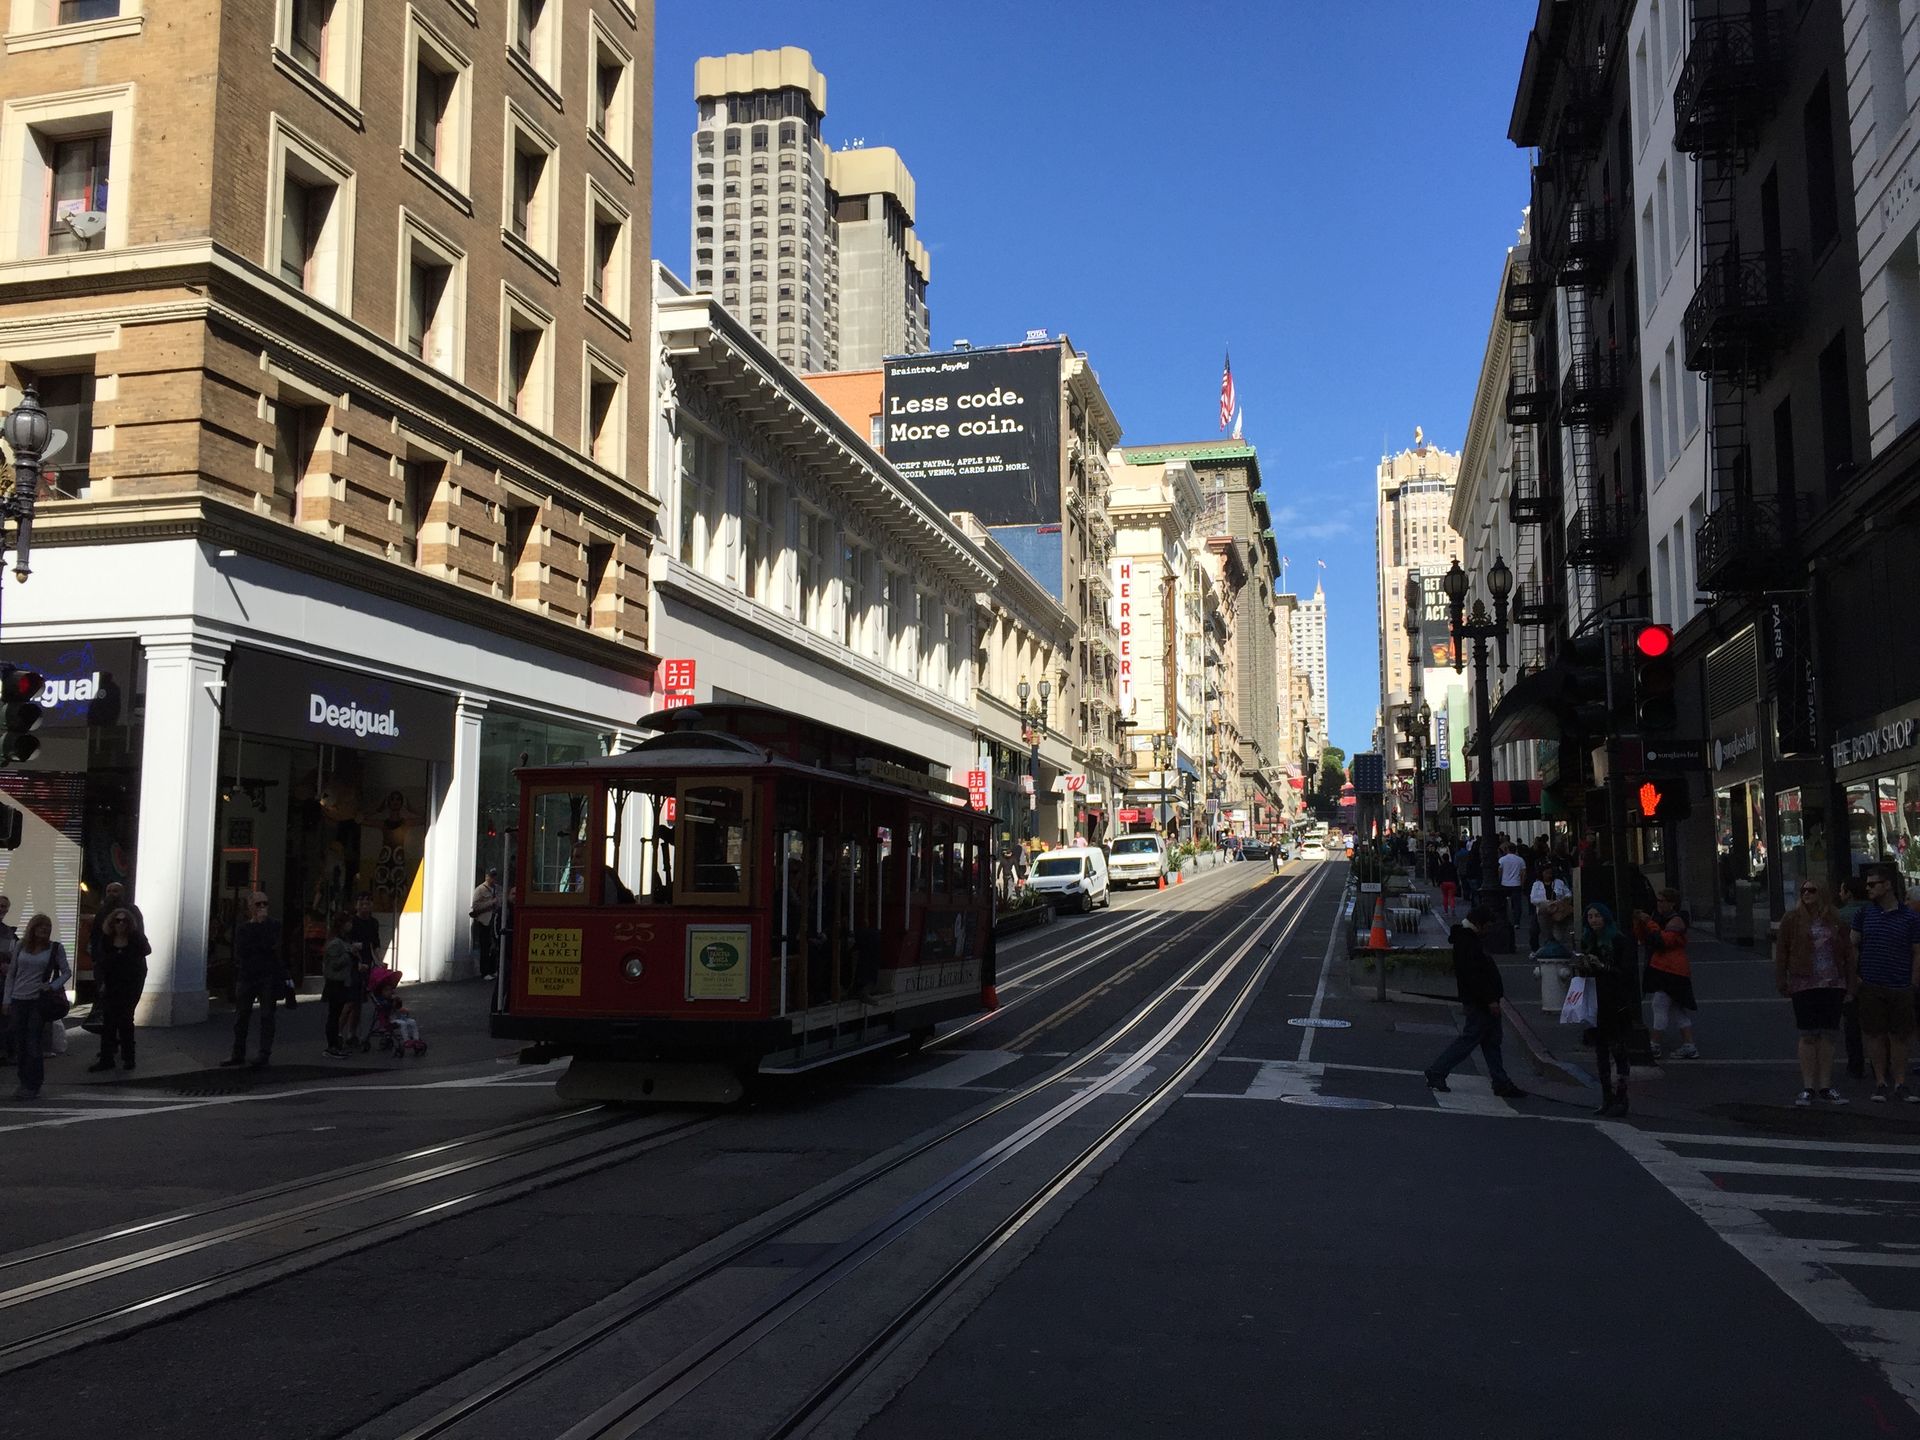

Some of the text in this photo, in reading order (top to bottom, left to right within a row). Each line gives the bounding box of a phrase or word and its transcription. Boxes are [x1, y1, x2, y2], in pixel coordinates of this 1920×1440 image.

[890, 387, 1024, 415] Less code.
[890, 414, 1024, 442] More coin.
[922, 460, 955, 468] PAYPAL,
[957, 457, 983, 466] APPLE
[985, 455, 1003, 464] PAY,
[928, 468, 957, 477] VENMO,
[959, 466, 985, 475] CARDS
[986, 464, 1004, 473] AND
[1005, 462, 1030, 471] MORE.
[1424, 578, 1441, 591] GET
[1425, 591, 1452, 605] IN TH
[1425, 605, 1449, 621] ACT.
[1120, 564, 1131, 694] HERBERT
[1771, 603, 1784, 659] PARIS
[667, 698, 688, 708] UNI
[309, 693, 396, 738] Desigual
[1831, 718, 1913, 768] THE BODY SHOP
[533, 933, 579, 942] POWELL
[612, 922, 656, 942] 25
[531, 948, 579, 957] MARKET
[544, 941, 568, 949] AND
